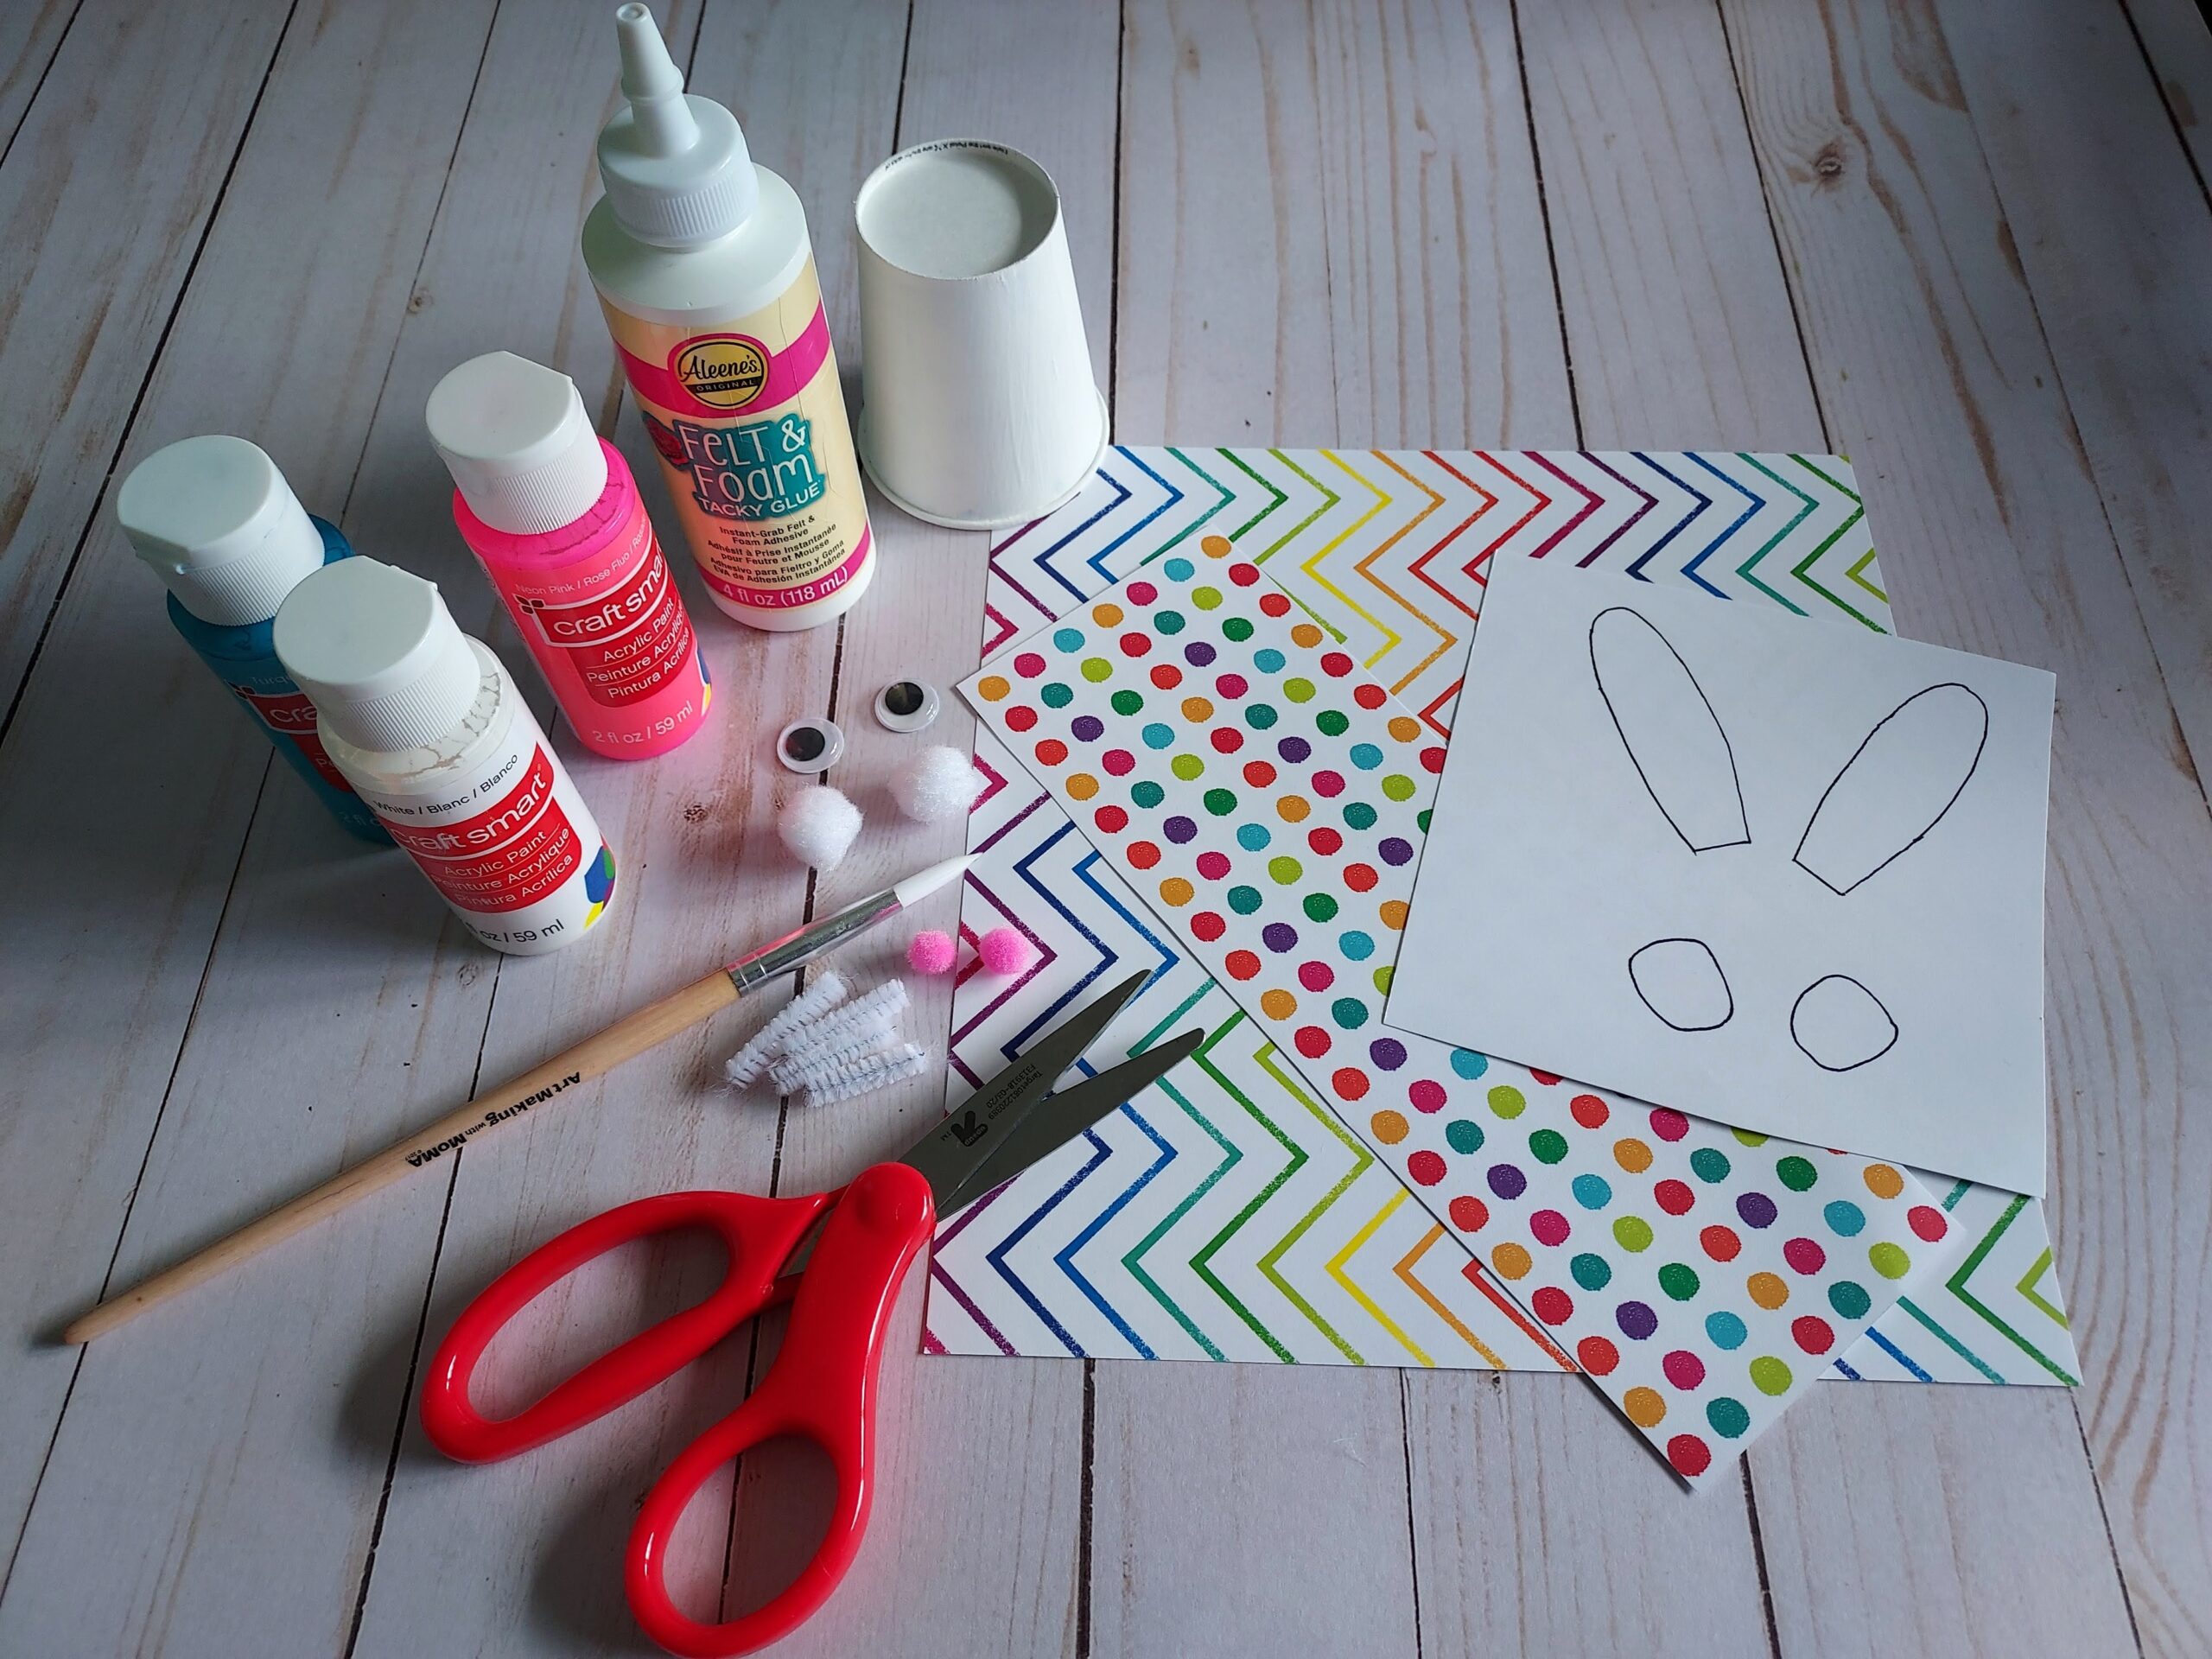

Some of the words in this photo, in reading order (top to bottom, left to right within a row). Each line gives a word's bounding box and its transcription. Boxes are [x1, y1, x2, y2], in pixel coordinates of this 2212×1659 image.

[679, 354, 760, 382] Aleene's
[696, 378, 756, 392] ORIGINAL
[780, 418, 806, 453] &
[696, 496, 764, 518] TACKY
[770, 483, 820, 513] GLUE
[708, 539, 744, 556] Adhésif
[755, 548, 782, 557] Prise
[784, 523, 837, 555] Instantanée
[719, 525, 785, 538] Instant-Grab
[786, 519, 806, 532] Felt
[807, 515, 816, 524] &
[732, 537, 760, 546] Foam
[763, 527, 809, 546] Adhesive
[710, 557, 753, 575] Adhesivo
[754, 569, 779, 578] para
[780, 560, 812, 575] Fieltro
[813, 555, 820, 565] y
[822, 539, 845, 559] Goma
[714, 565, 730, 577] EVA
[731, 571, 745, 581] de
[747, 574, 793, 584] Adhesión
[795, 548, 846, 581] Instantánea
[721, 552, 743, 563] pour
[745, 556, 779, 566] Feutre
[781, 554, 793, 563] et
[794, 538, 830, 560] Mousse
[515, 583, 547, 595] Neon
[549, 582, 575, 595] Pink
[576, 580, 582, 590] /
[583, 568, 611, 587] Rose
[611, 552, 630, 574] Fluo
[722, 584, 734, 597] 4
[737, 589, 749, 602] fl
[754, 594, 777, 606] oz
[779, 586, 816, 607] (118
[820, 565, 849, 595] mL)
[553, 603, 626, 636] craft
[604, 630, 653, 663] Acrylic
[652, 597, 675, 633] Paint
[585, 655, 652, 683] Peinture
[607, 671, 662, 699] Pintura
[592, 730, 605, 744] 2
[607, 732, 620, 744] fl
[622, 731, 645, 744] oz
[655, 716, 676, 735] 59
[677, 700, 692, 725] ml
[372, 798, 415, 816] White
[418, 805, 423, 816] /
[428, 794, 470, 815] Blanc
[472, 787, 478, 800] /
[480, 754, 518, 793] Blanco
[390, 827, 467, 851] craft
[467, 772, 548, 845] smart
[431, 874, 503, 893] Peinture
[507, 826, 570, 885] Acrylique
[444, 859, 505, 879] Acrylic
[505, 830, 548, 863] Paint
[454, 893, 517, 906] Pintura
[521, 854, 574, 899] Acrílica
[480, 930, 502, 943] oz
[512, 930, 537, 943] 59
[541, 918, 565, 938] ml
[553, 1071, 582, 1094] Art
[485, 1089, 555, 1128] Making
[465, 1122, 487, 1136] with
[407, 1133, 468, 1168] MoMA
